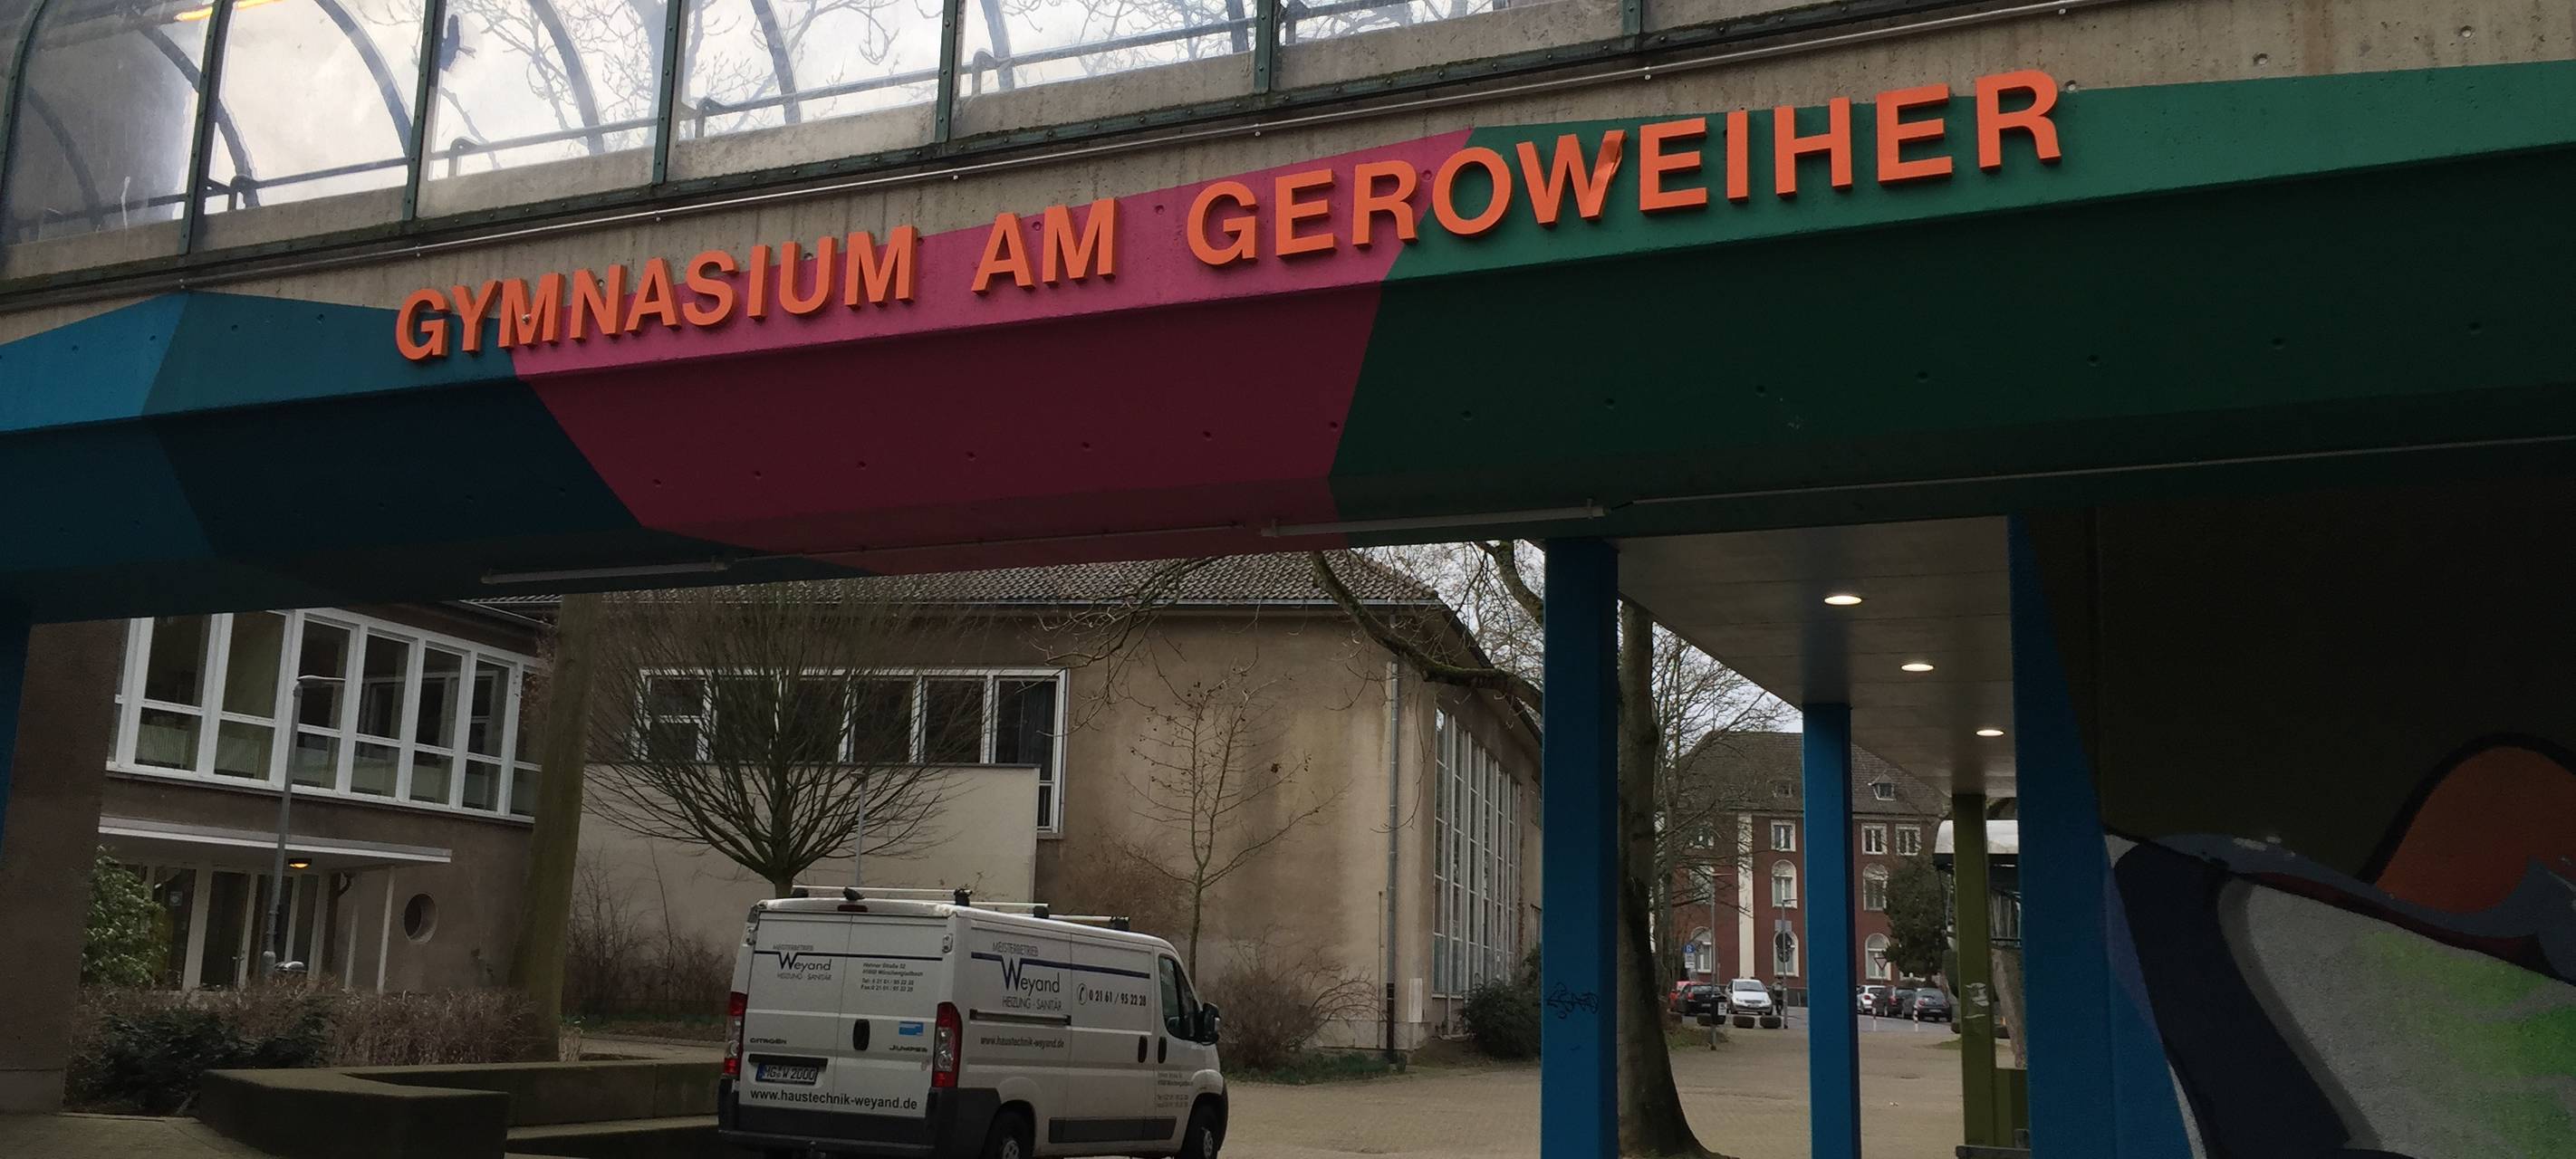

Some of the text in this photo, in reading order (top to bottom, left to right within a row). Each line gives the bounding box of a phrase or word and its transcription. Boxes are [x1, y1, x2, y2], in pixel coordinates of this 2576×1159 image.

[395, 69, 2062, 360] GYMNASIUM AM GEROWEIHER
[778, 952, 832, 972] Weyand
[1000, 955, 1061, 996] Weyand
[1003, 996, 1032, 1009] HEIZUNG
[1095, 990, 1103, 1002] 21
[1105, 991, 1112, 1002] 61
[1120, 992, 1129, 1004] 95
[1130, 993, 1138, 1005] 22
[980, 1035, 1065, 1049] www.haustechnik-weyand.de
[751, 1089, 918, 1110] www.haustechnik-weyand.de
